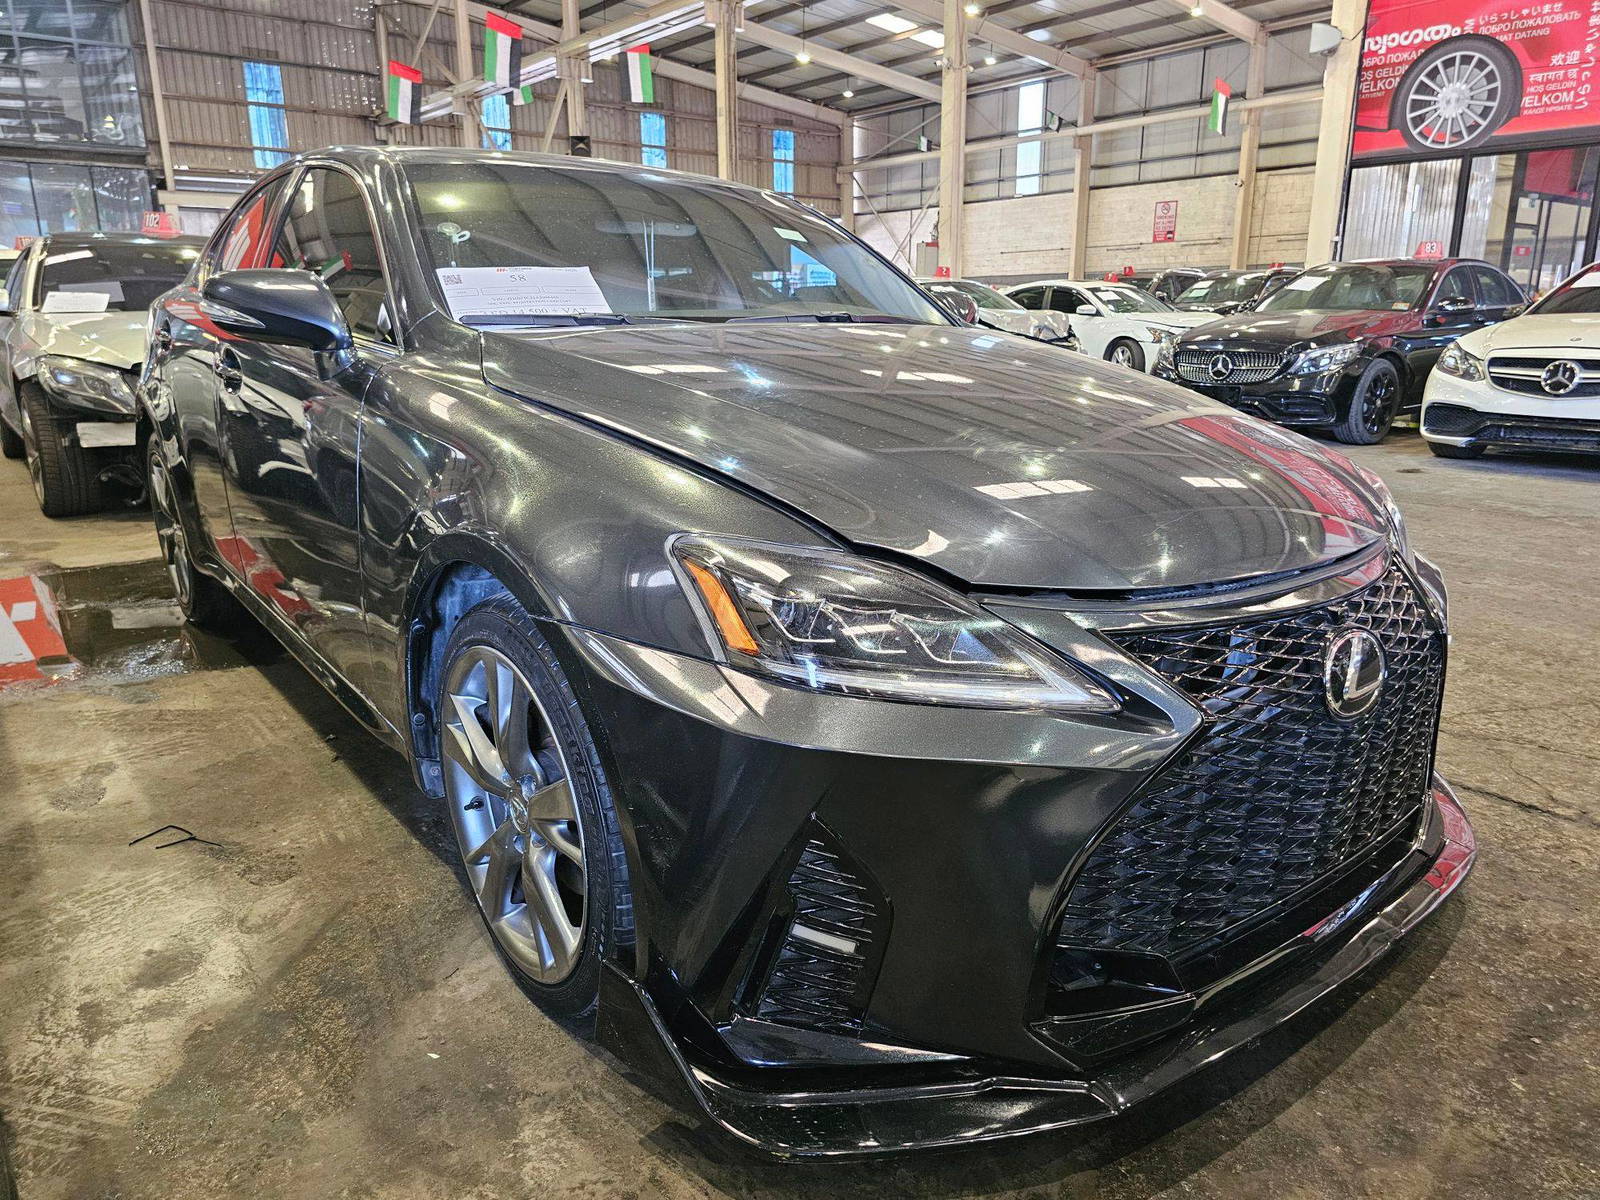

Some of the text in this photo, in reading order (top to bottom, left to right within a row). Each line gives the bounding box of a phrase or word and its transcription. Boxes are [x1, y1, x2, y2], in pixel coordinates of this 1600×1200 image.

[1479, 3, 1563, 25] いらっしゃいませ
[1511, 10, 1582, 30] ПОЖАЛОВАТЬ
[1514, 27, 1551, 40] DATANG
[1549, 50, 1580, 67] 欢迎
[145, 212, 160, 228] 102
[1425, 242, 1437, 253] 83
[509, 273, 528, 283] 58
